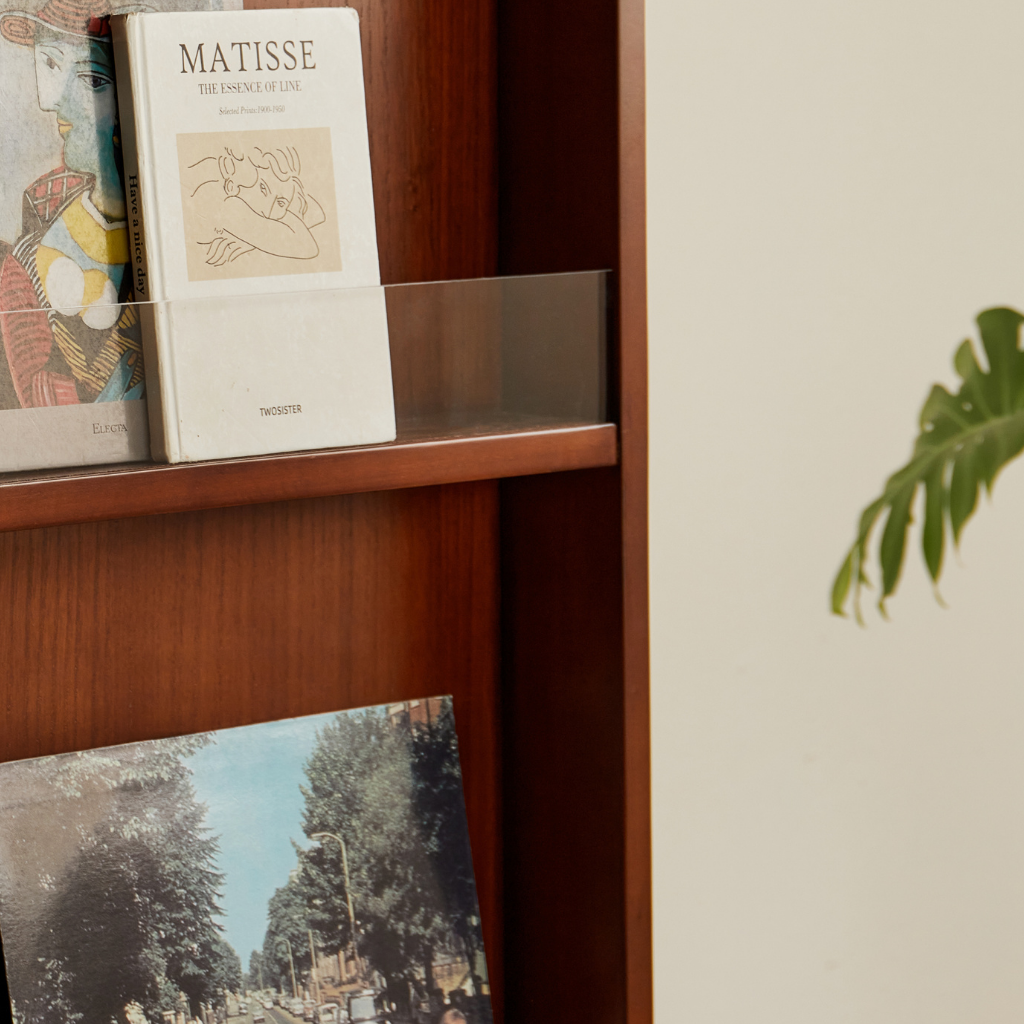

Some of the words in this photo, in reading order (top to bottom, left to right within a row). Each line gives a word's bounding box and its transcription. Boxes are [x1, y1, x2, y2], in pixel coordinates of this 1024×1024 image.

[178, 39, 317, 74] MATISSE
[198, 82, 219, 95] THE
[220, 81, 263, 94] ESSENCE
[264, 80, 278, 93] OF
[279, 80, 302, 92] LINE
[218, 106, 240, 116] Selected
[128, 174, 139, 215] Have
[132, 218, 140, 228] a
[133, 231, 144, 264] nice
[137, 267, 146, 296] day
[259, 404, 303, 417] TWOSISTER
